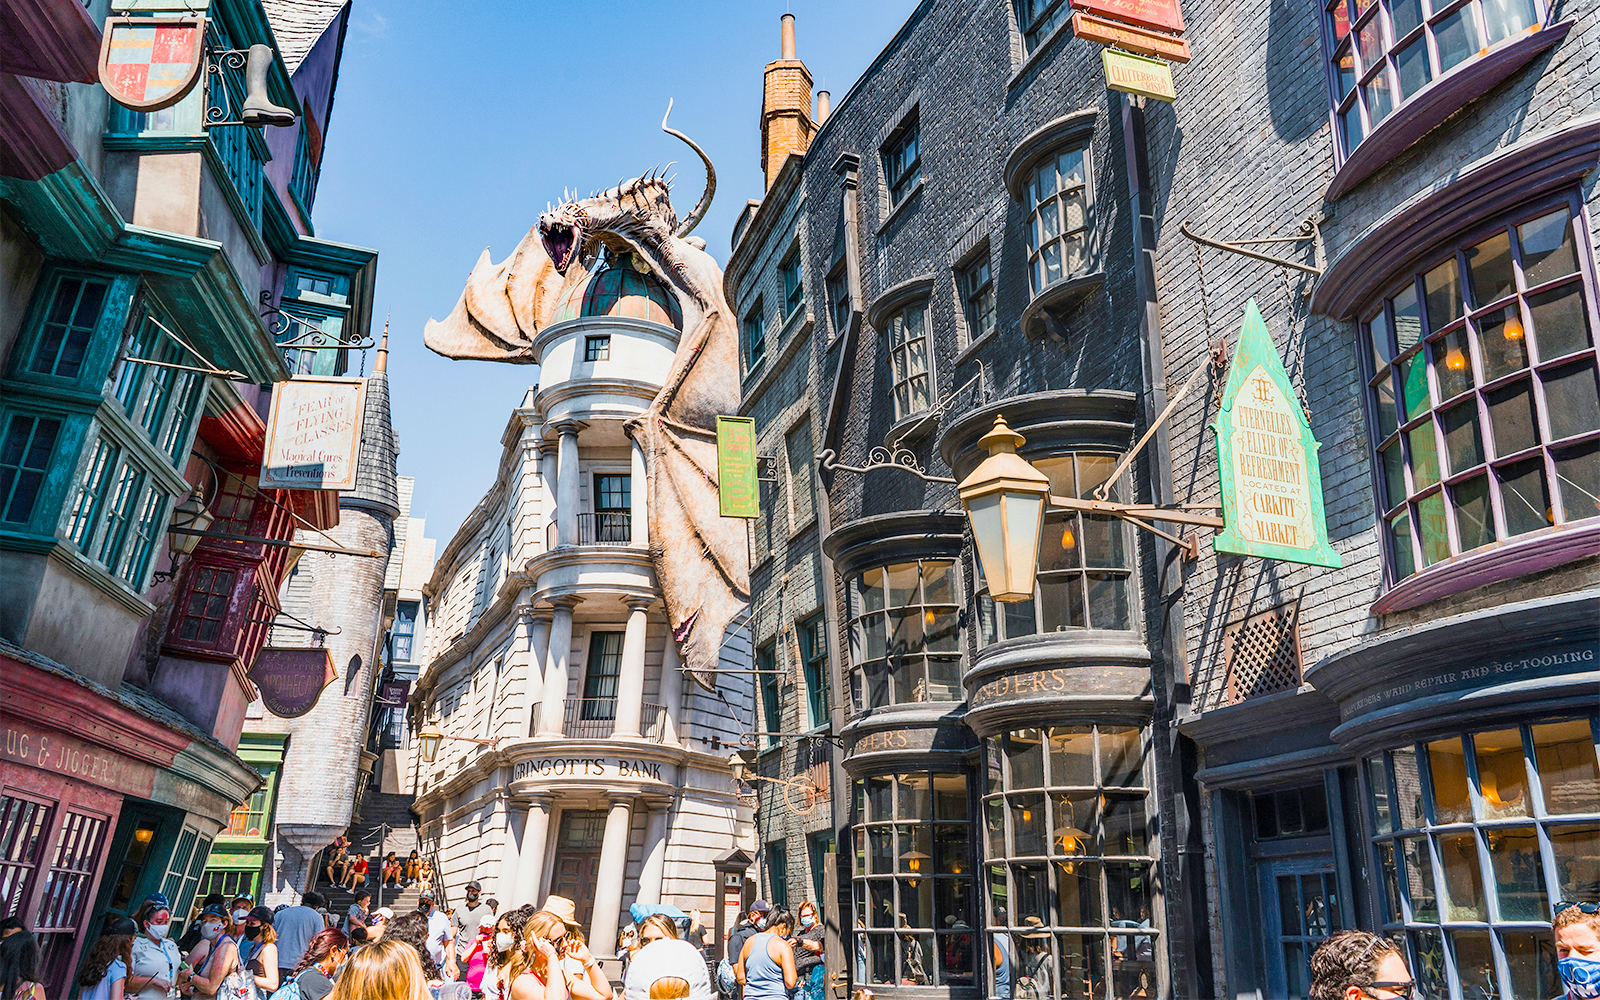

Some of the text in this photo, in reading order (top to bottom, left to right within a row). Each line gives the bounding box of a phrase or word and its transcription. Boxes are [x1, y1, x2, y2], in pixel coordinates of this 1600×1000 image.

[1111, 65, 1169, 86] CLUTTERBUCK
[298, 396, 332, 416] FEAR
[296, 407, 343, 431] FLYING
[1238, 405, 1293, 435] ETERNELLE'S
[294, 418, 353, 447] CLASSES
[1246, 430, 1289, 459] ELIXIR OF
[280, 448, 343, 464] Magical Cures
[286, 464, 336, 479] Preventions
[1239, 453, 1301, 485] REFRESHMENT
[1243, 479, 1302, 496] LOCATED AT
[1252, 492, 1296, 518] CARKITT
[1255, 519, 1298, 546] MARKET
[262, 674, 325, 699] APOTHECARY
[1383, 684, 1413, 700] WAND
[1414, 673, 1458, 690] REPAIR
[1461, 666, 1490, 680] AND
[1494, 650, 1595, 674] RE-TOOLING
[269, 698, 313, 714] DIAGON ALLEY
[0, 729, 118, 783] UG & JIGGERS
[514, 758, 662, 781] GRINGOTTS BANK
